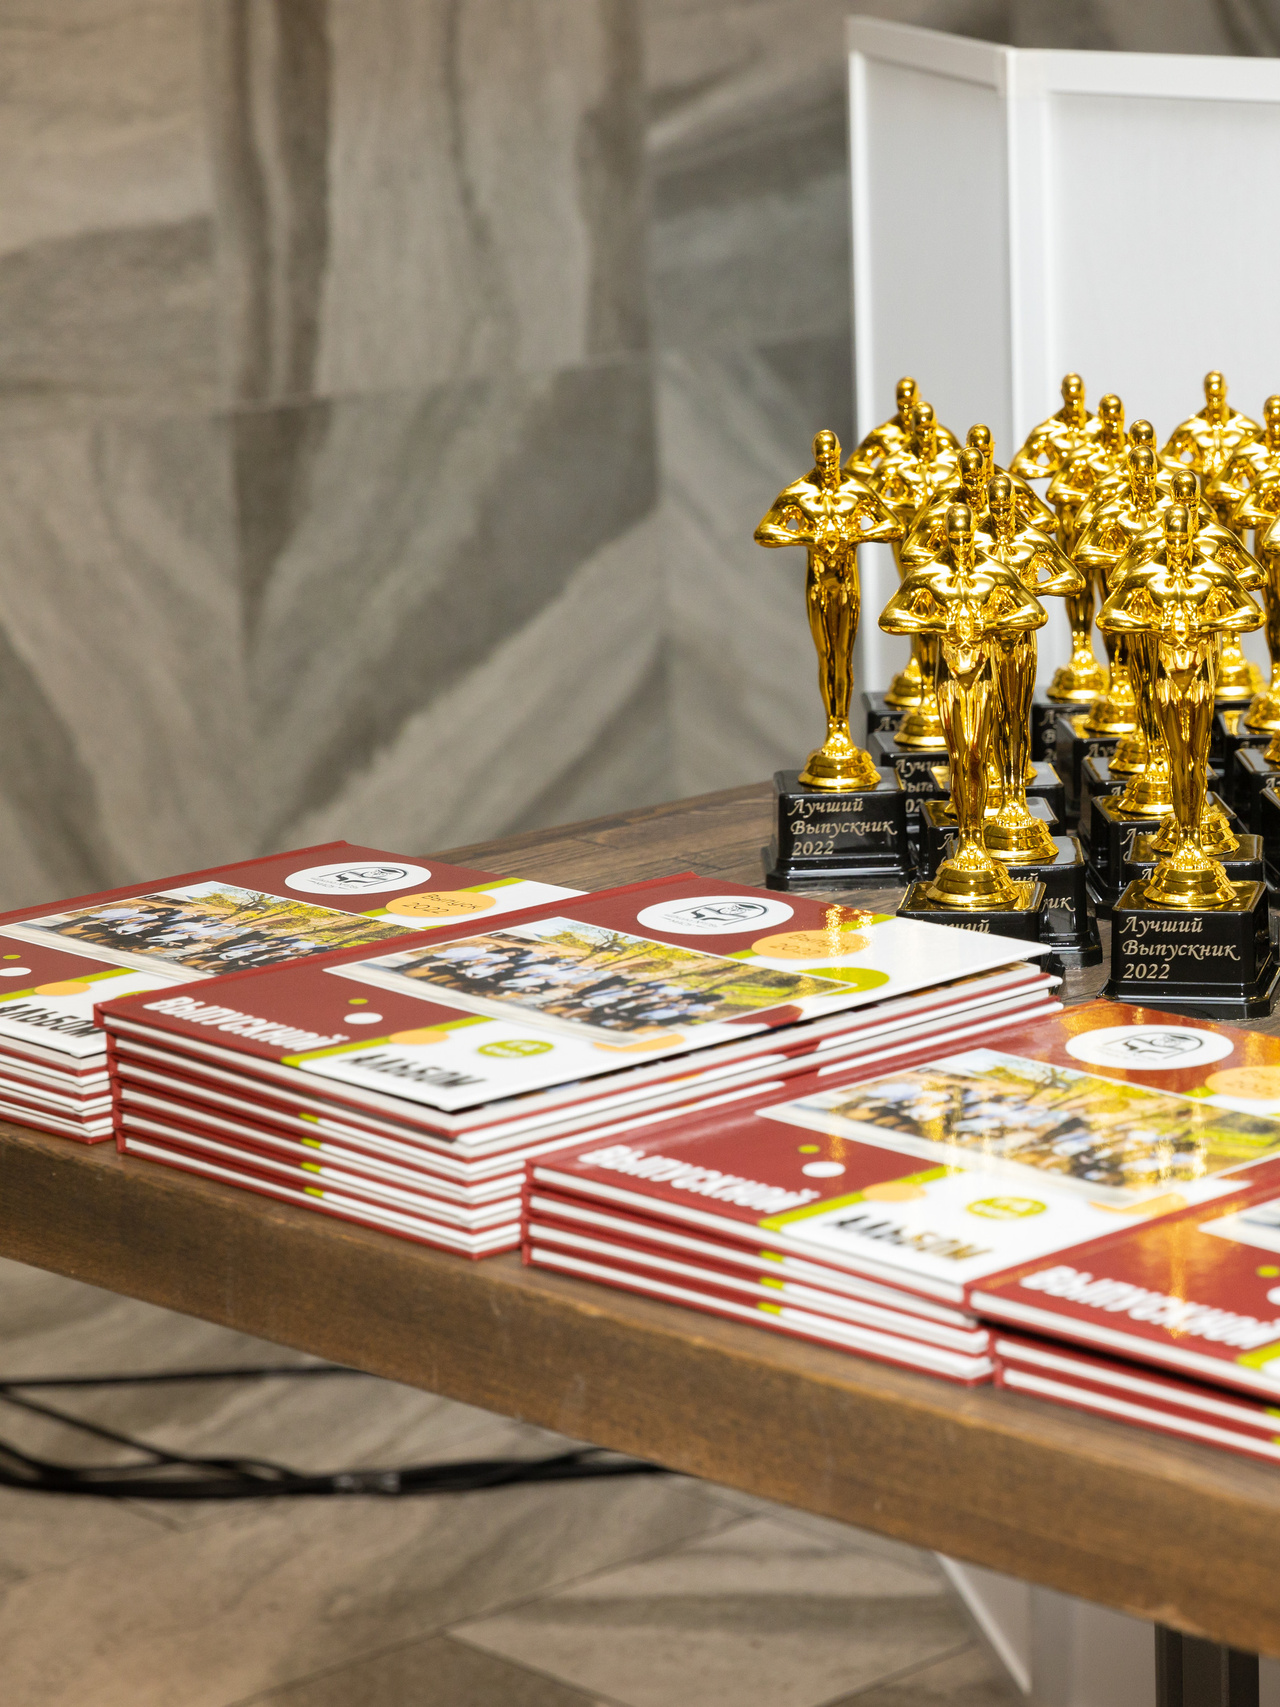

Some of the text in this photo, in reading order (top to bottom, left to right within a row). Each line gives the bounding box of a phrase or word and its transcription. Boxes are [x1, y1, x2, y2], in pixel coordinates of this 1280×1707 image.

[787, 797, 864, 819] Лучший
[790, 820, 898, 839] Выпускник
[791, 840, 835, 856] 2022
[401, 902, 450, 915] 2022
[1118, 915, 1203, 938] Лучший
[1122, 939, 1241, 962] Выпускник
[1122, 963, 1170, 979] 2022
[143, 995, 351, 1052] ВЫПУСКНОЙ
[340, 1052, 490, 1089] АЛЬБОМ
[578, 1144, 822, 1215] ВЫПУСКНОЙ
